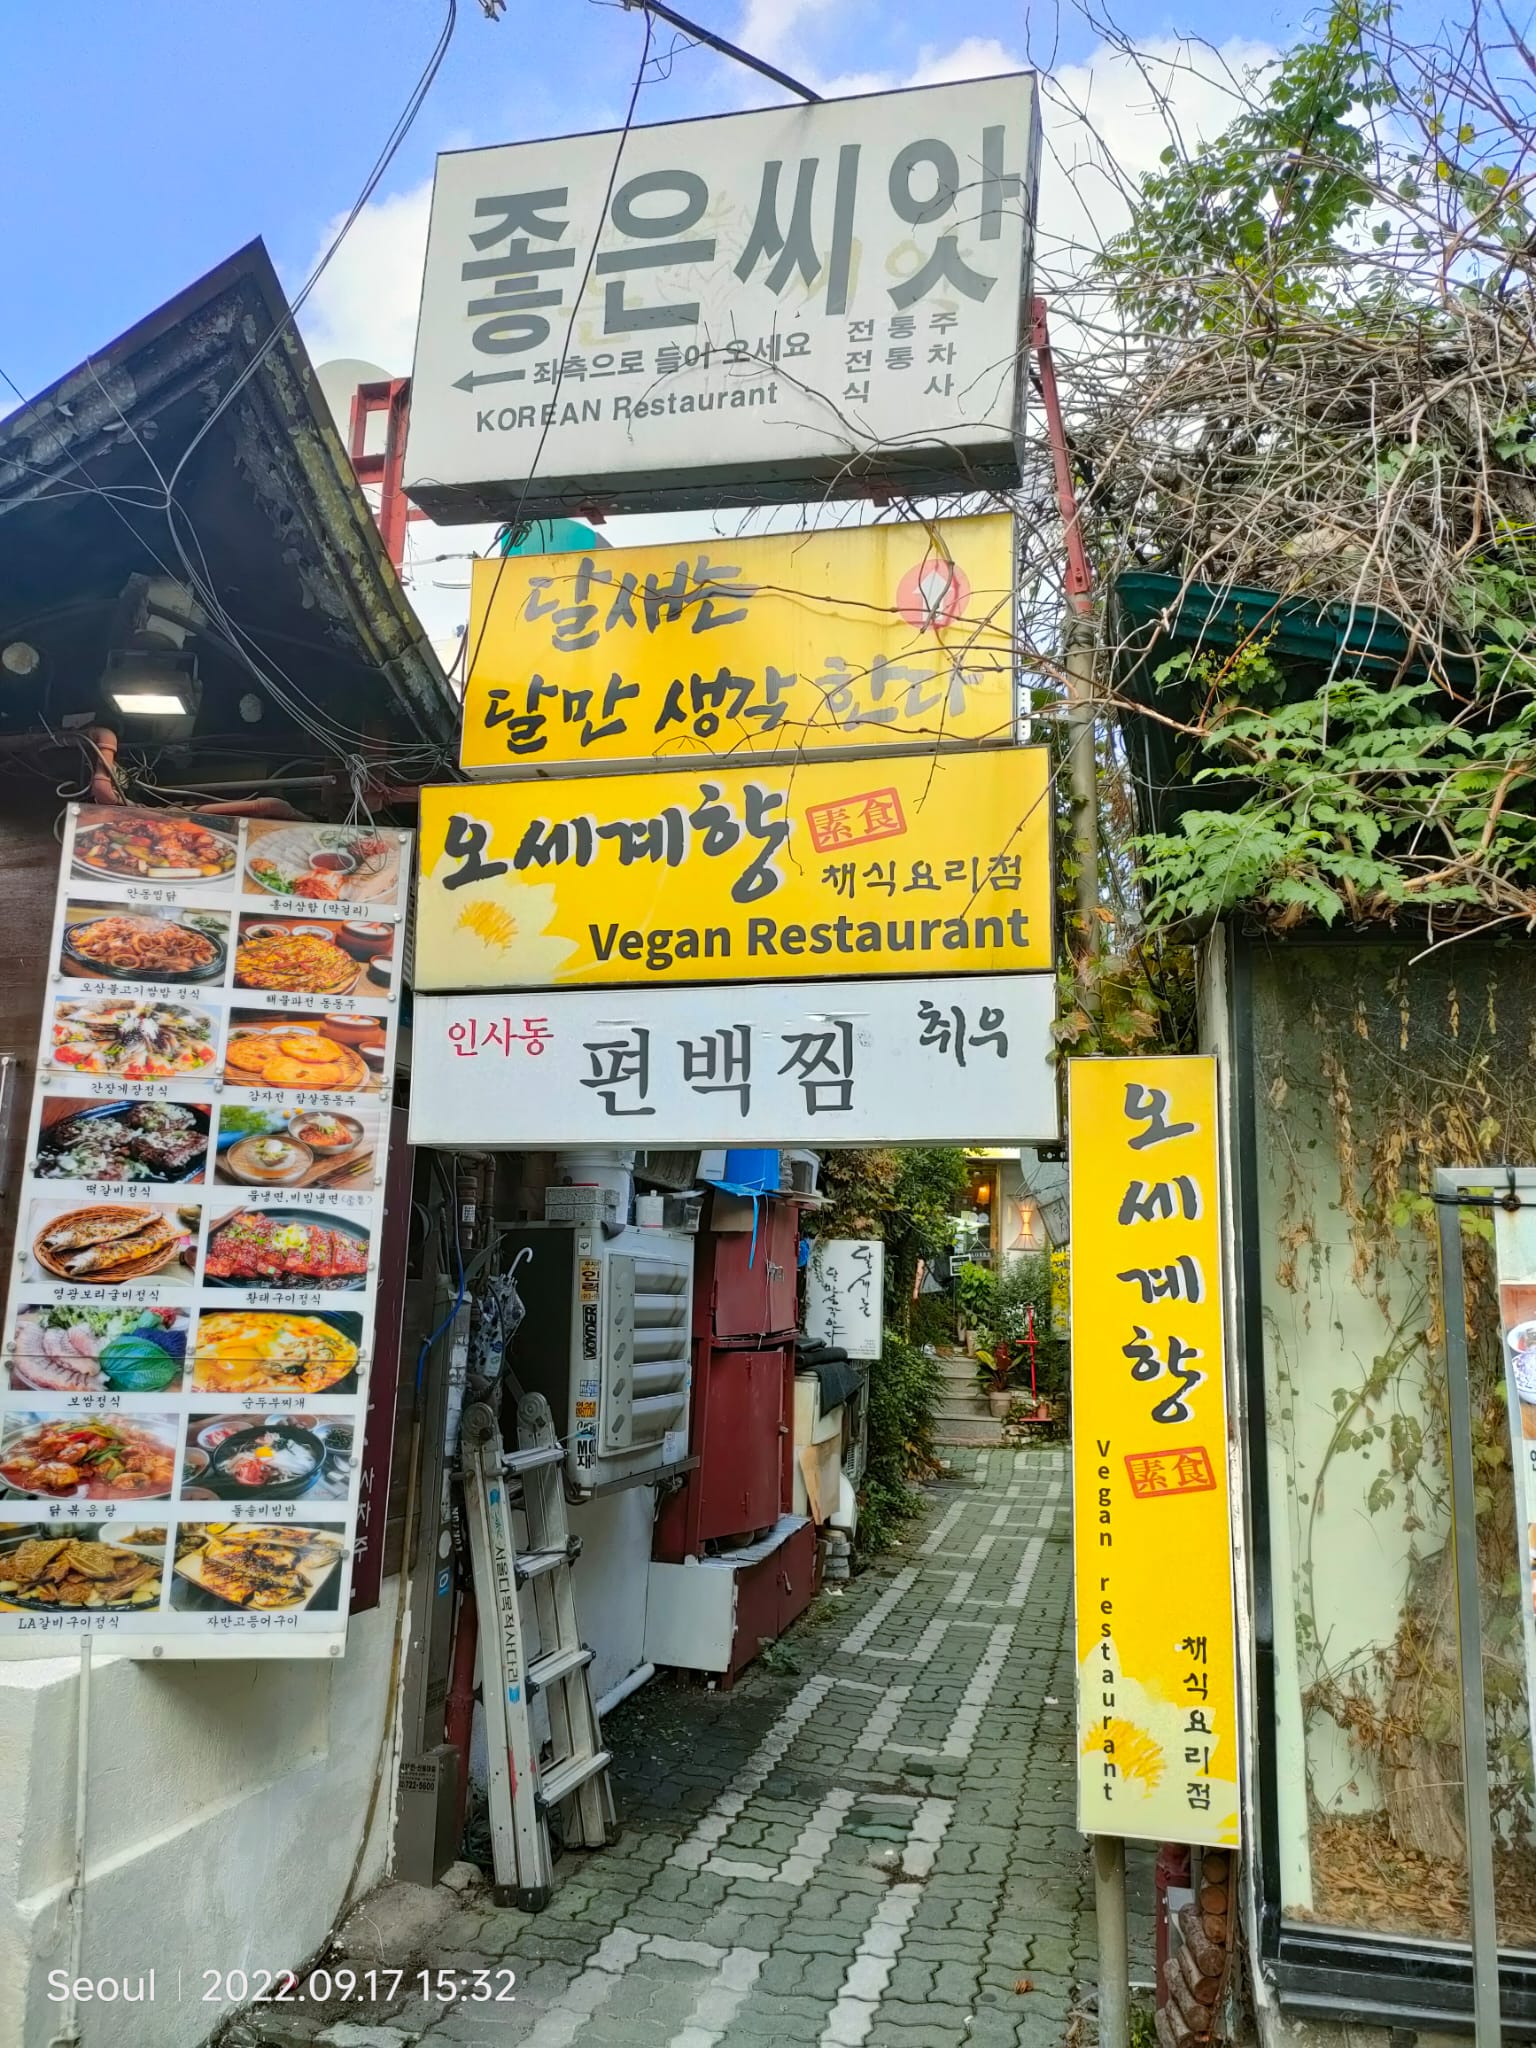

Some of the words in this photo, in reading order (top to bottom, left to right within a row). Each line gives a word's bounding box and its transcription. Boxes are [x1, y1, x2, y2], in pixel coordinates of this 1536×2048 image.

[533, 349, 645, 387] 좌측으로
[654, 342, 710, 374] 들어
[724, 331, 812, 365] 오세요
[844, 343, 957, 373] 전통차
[847, 311, 959, 343] 전통주
[475, 399, 601, 434] KOREAN
[612, 382, 779, 422] Restaurant
[524, 553, 759, 652] 달새는
[484, 672, 639, 754] 달만
[441, 783, 788, 904] 오세계향
[813, 795, 902, 847] 素食
[822, 855, 1024, 898] 채식요리점
[589, 921, 732, 971] Vegan
[747, 906, 1031, 957] Restaurant
[447, 1016, 554, 1058] 인사동
[917, 1000, 1009, 1067] 취우
[579, 1018, 857, 1118] 편백찜
[1117, 1083, 1202, 1424] 오세계향
[1096, 1439, 1113, 1548] Vegan
[1131, 1455, 1209, 1492] 素食
[1100, 1574, 1118, 1802] restaurant
[1182, 1635, 1212, 1811] 채식요리점
